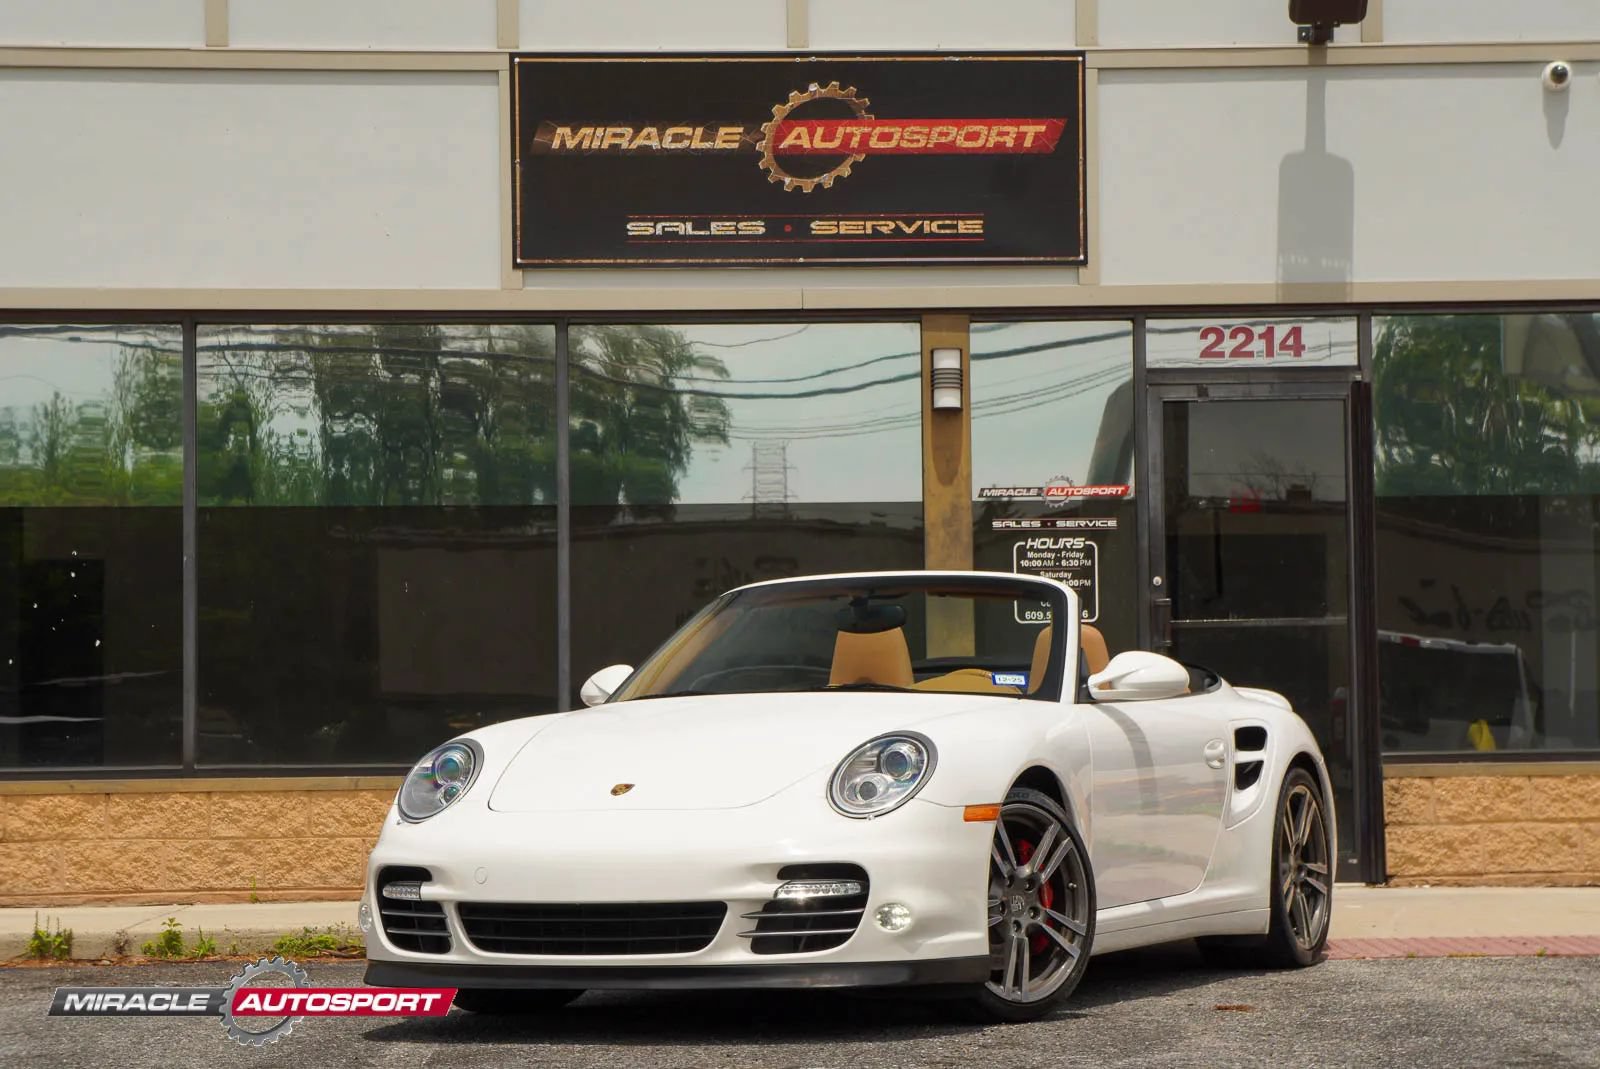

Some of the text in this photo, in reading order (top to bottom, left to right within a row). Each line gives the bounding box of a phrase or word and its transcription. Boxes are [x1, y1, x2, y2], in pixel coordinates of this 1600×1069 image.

[551, 124, 1047, 149] MIRACLE AUTOSPORT
[626, 219, 984, 236] SALES SERVICE
[1199, 326, 1305, 358] 2214
[1048, 487, 1125, 496] AUTOSPORT
[1026, 538, 1085, 549] HOURS
[1061, 551, 1084, 559] Friday
